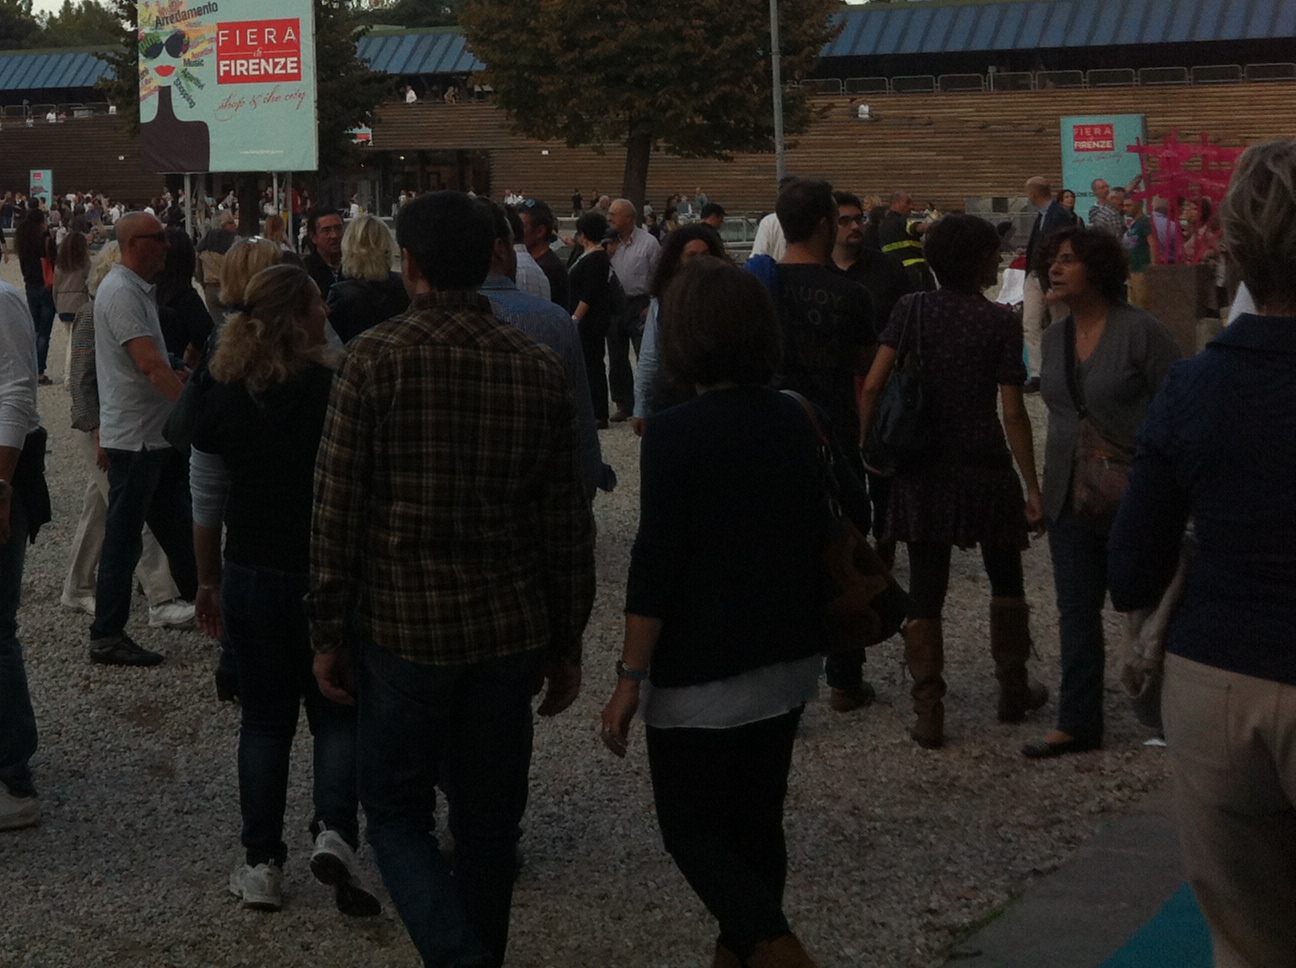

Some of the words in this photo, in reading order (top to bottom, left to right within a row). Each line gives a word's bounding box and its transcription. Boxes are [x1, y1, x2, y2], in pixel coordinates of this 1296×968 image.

[155, 1, 219, 29] Arredamento
[218, 26, 297, 46] FIERA
[183, 58, 205, 67] Music
[219, 57, 298, 76] FIRENZE
[173, 78, 196, 109] Shopping
[1074, 127, 1112, 136] FIERA
[1074, 140, 1112, 149] FIRENZE
